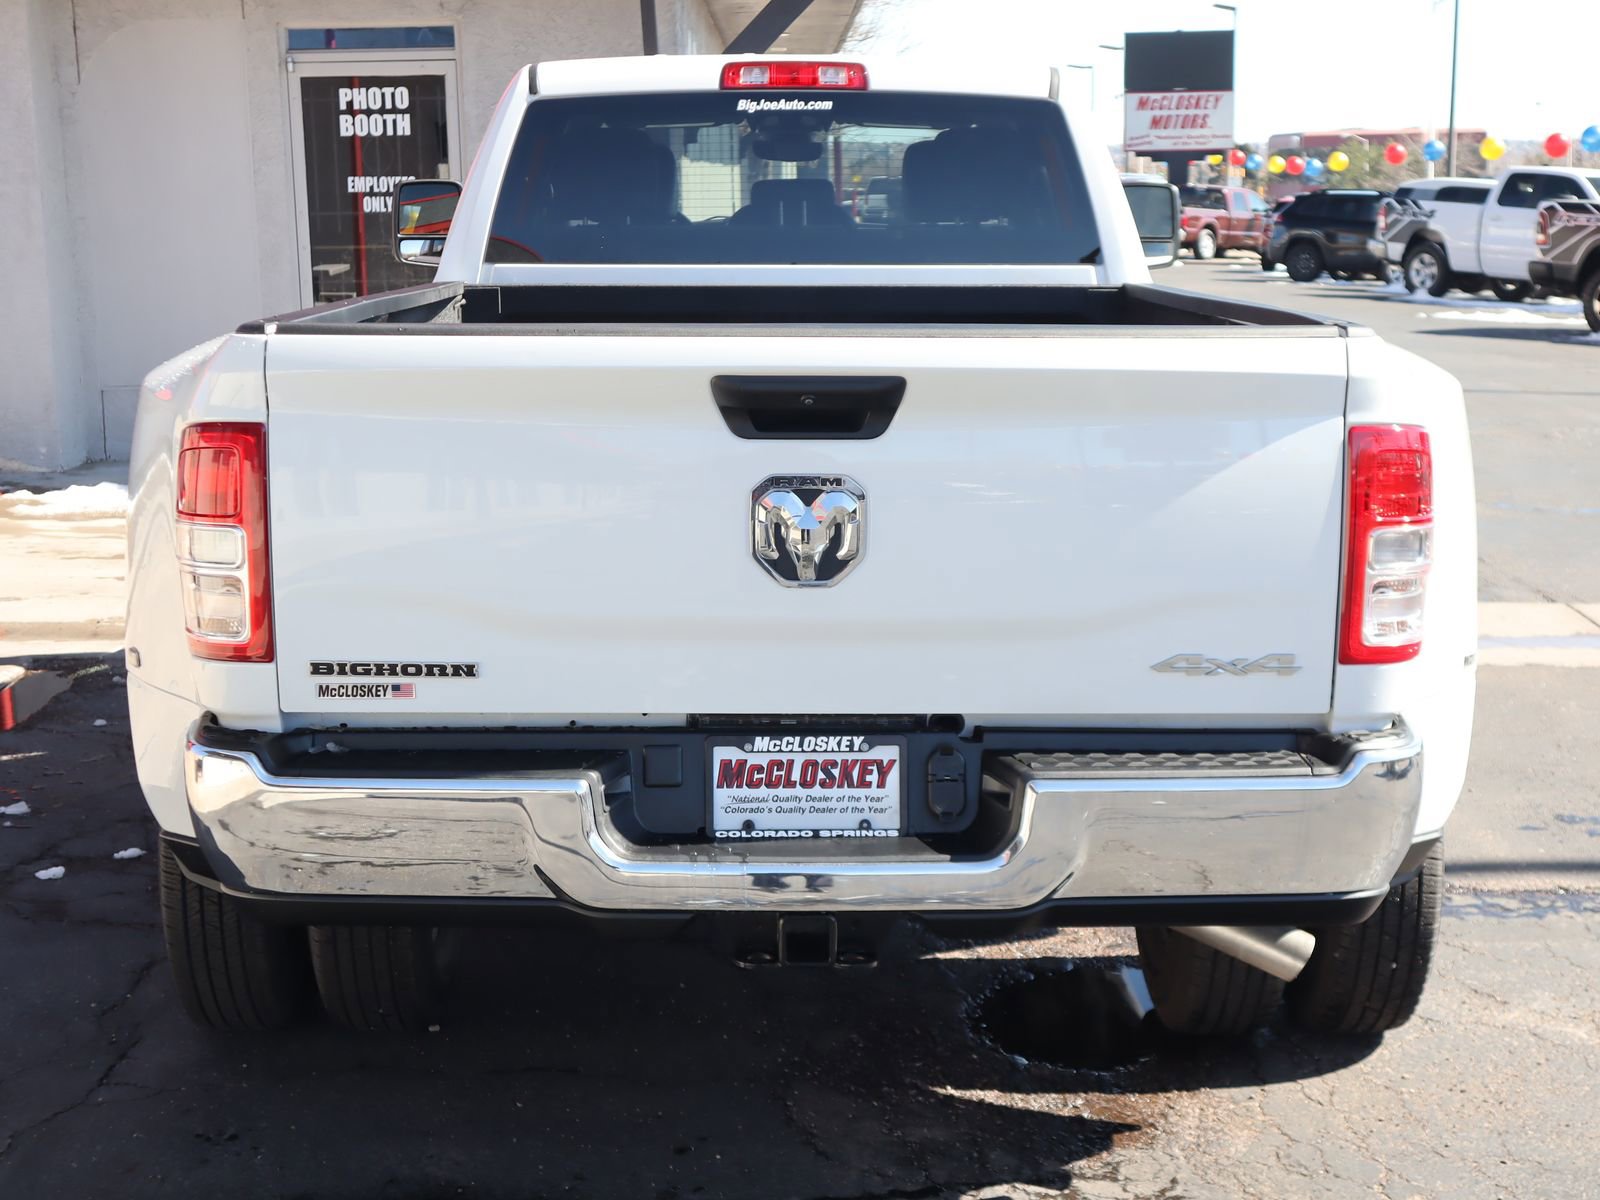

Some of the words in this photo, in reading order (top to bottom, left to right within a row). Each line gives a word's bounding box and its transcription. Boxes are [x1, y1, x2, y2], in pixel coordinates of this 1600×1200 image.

[338, 86, 409, 111] PHOTO
[736, 98, 833, 113] BigJoeAuto.com
[339, 113, 411, 137] BOOTH
[1149, 113, 1211, 130] MOTORS
[347, 175, 416, 193] EMPLOY
[363, 195, 393, 213] ONLY
[774, 476, 843, 488] RAM
[309, 661, 478, 677] BIGHORN
[318, 684, 389, 698] McCLOSKEY
[753, 735, 865, 752] McCLOSKEY
[716, 758, 897, 790] McCLOSKEY
[771, 794, 803, 804] Quality
[805, 794, 833, 803] Dealer
[834, 794, 846, 803] of
[848, 794, 862, 803] the
[775, 805, 806, 815] Quality
[808, 806, 837, 814] Dealer
[839, 805, 850, 814] of
[851, 805, 865, 814] the
[715, 830, 814, 838] COLORADO
[819, 830, 899, 838] SPRINGS
